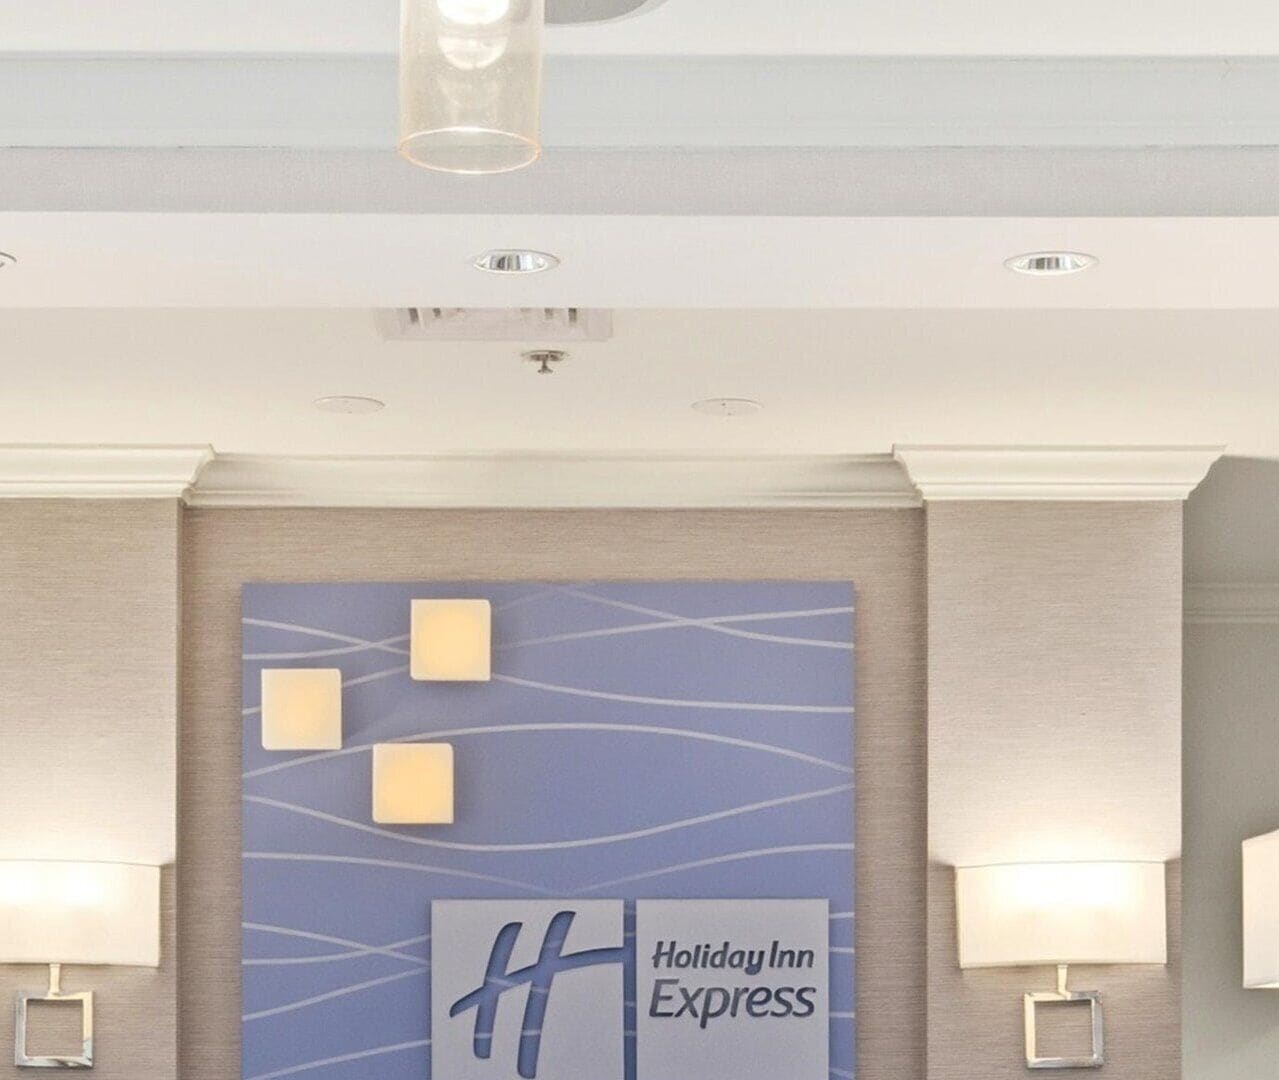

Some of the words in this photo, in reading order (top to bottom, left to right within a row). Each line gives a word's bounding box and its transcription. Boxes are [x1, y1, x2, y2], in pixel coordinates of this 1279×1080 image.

[652, 940, 764, 975] Holiday
[770, 940, 814, 969] Inn
[649, 978, 817, 1029] Express
